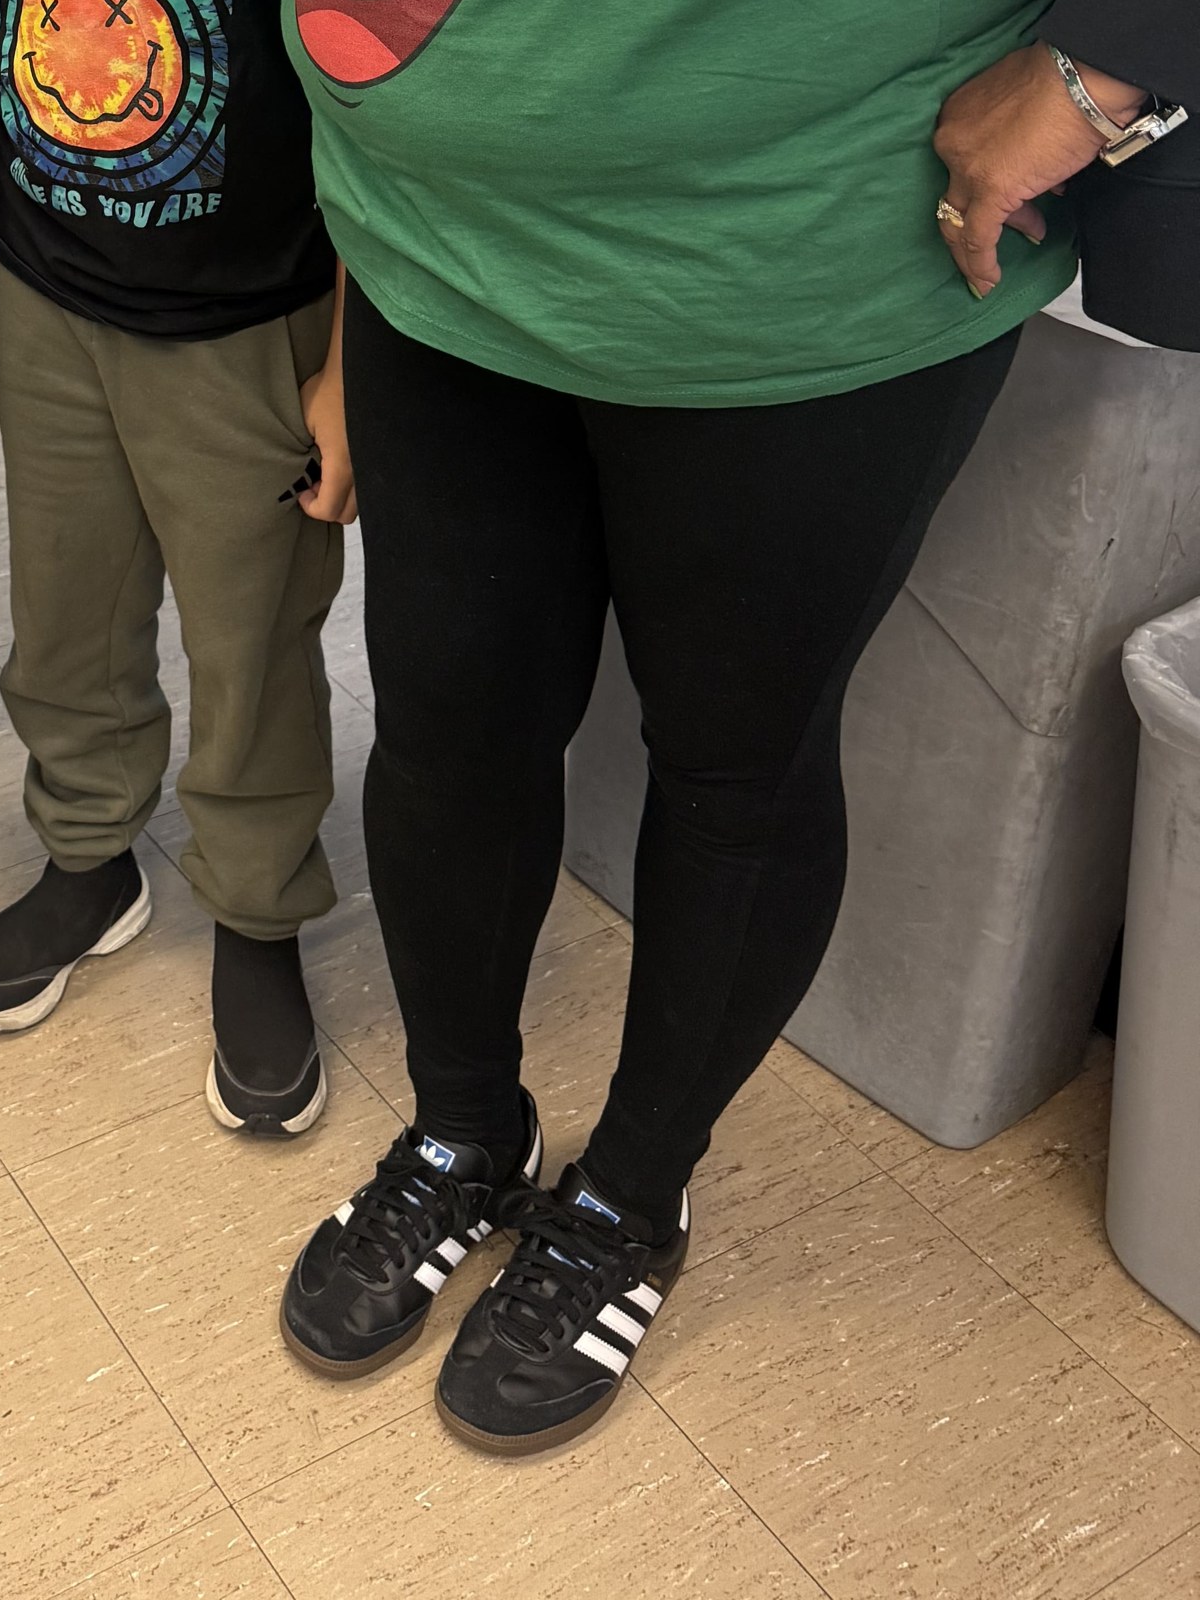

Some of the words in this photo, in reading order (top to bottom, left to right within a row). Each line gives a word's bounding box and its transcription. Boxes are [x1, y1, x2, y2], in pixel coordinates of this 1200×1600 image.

[51, 184, 87, 217] AS
[98, 194, 156, 229] YOU
[156, 193, 223, 228] ARE
